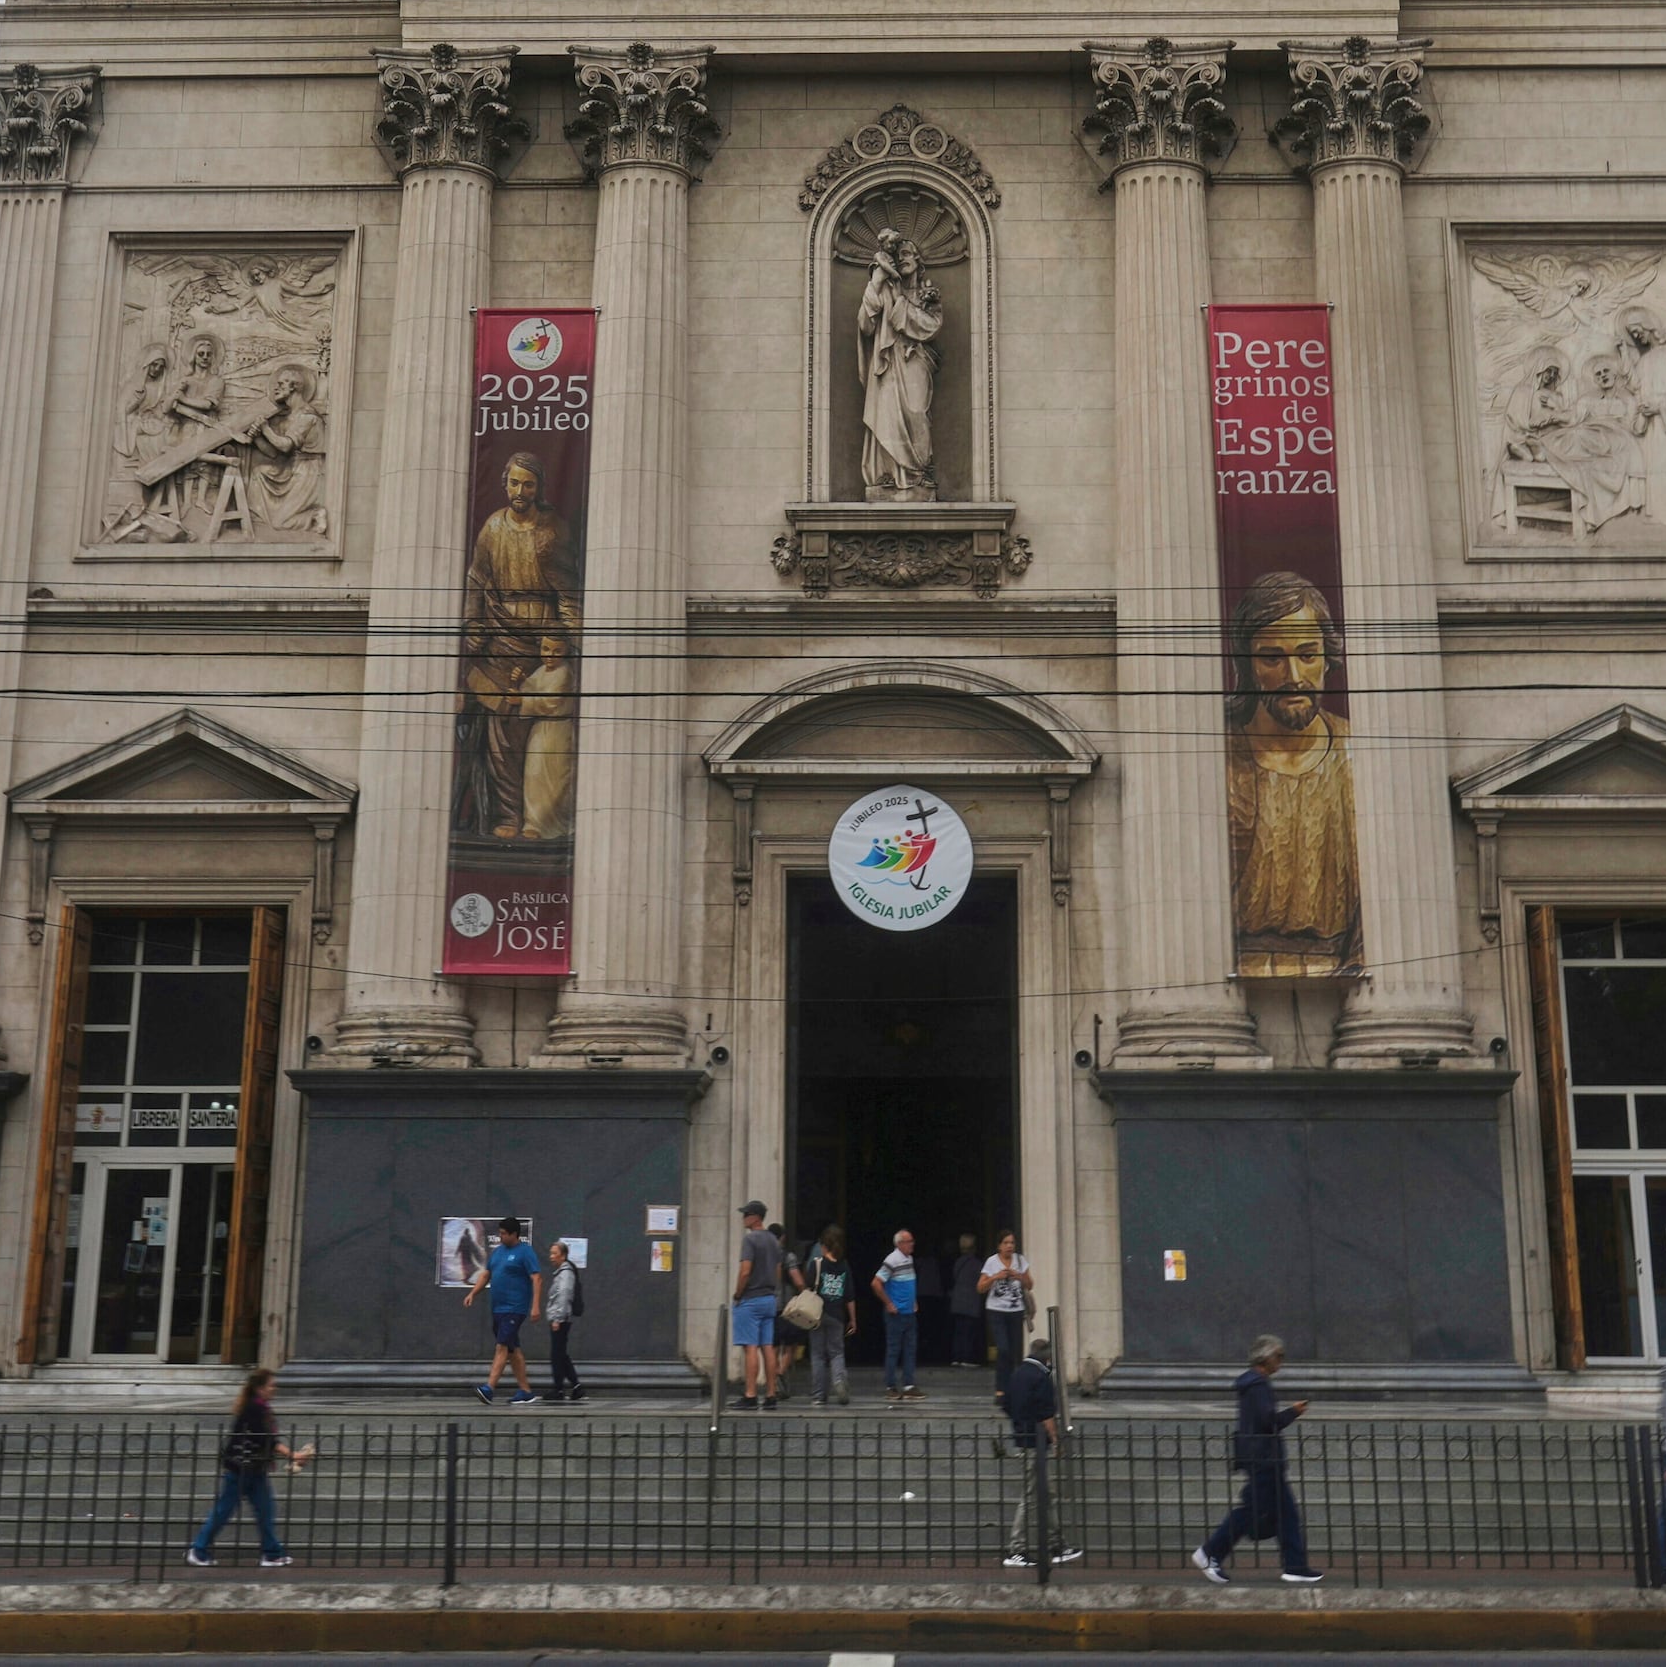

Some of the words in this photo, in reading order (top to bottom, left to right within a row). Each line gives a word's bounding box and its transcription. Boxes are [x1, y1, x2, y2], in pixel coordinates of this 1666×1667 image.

[1213, 332, 1326, 369] Pere
[479, 374, 588, 409] 2025
[1214, 368, 1330, 405] grinos
[475, 405, 590, 436] Jubileo
[1282, 400, 1318, 424] de
[1215, 418, 1333, 466] Espe
[1217, 468, 1336, 494] ranza
[849, 801, 883, 833] JUBILEO
[884, 796, 909, 808] 2025
[497, 899, 539, 921] SAN
[847, 881, 895, 919] IGLESIA
[898, 884, 952, 920] JUBILAR
[493, 921, 566, 957] JOSÉ
